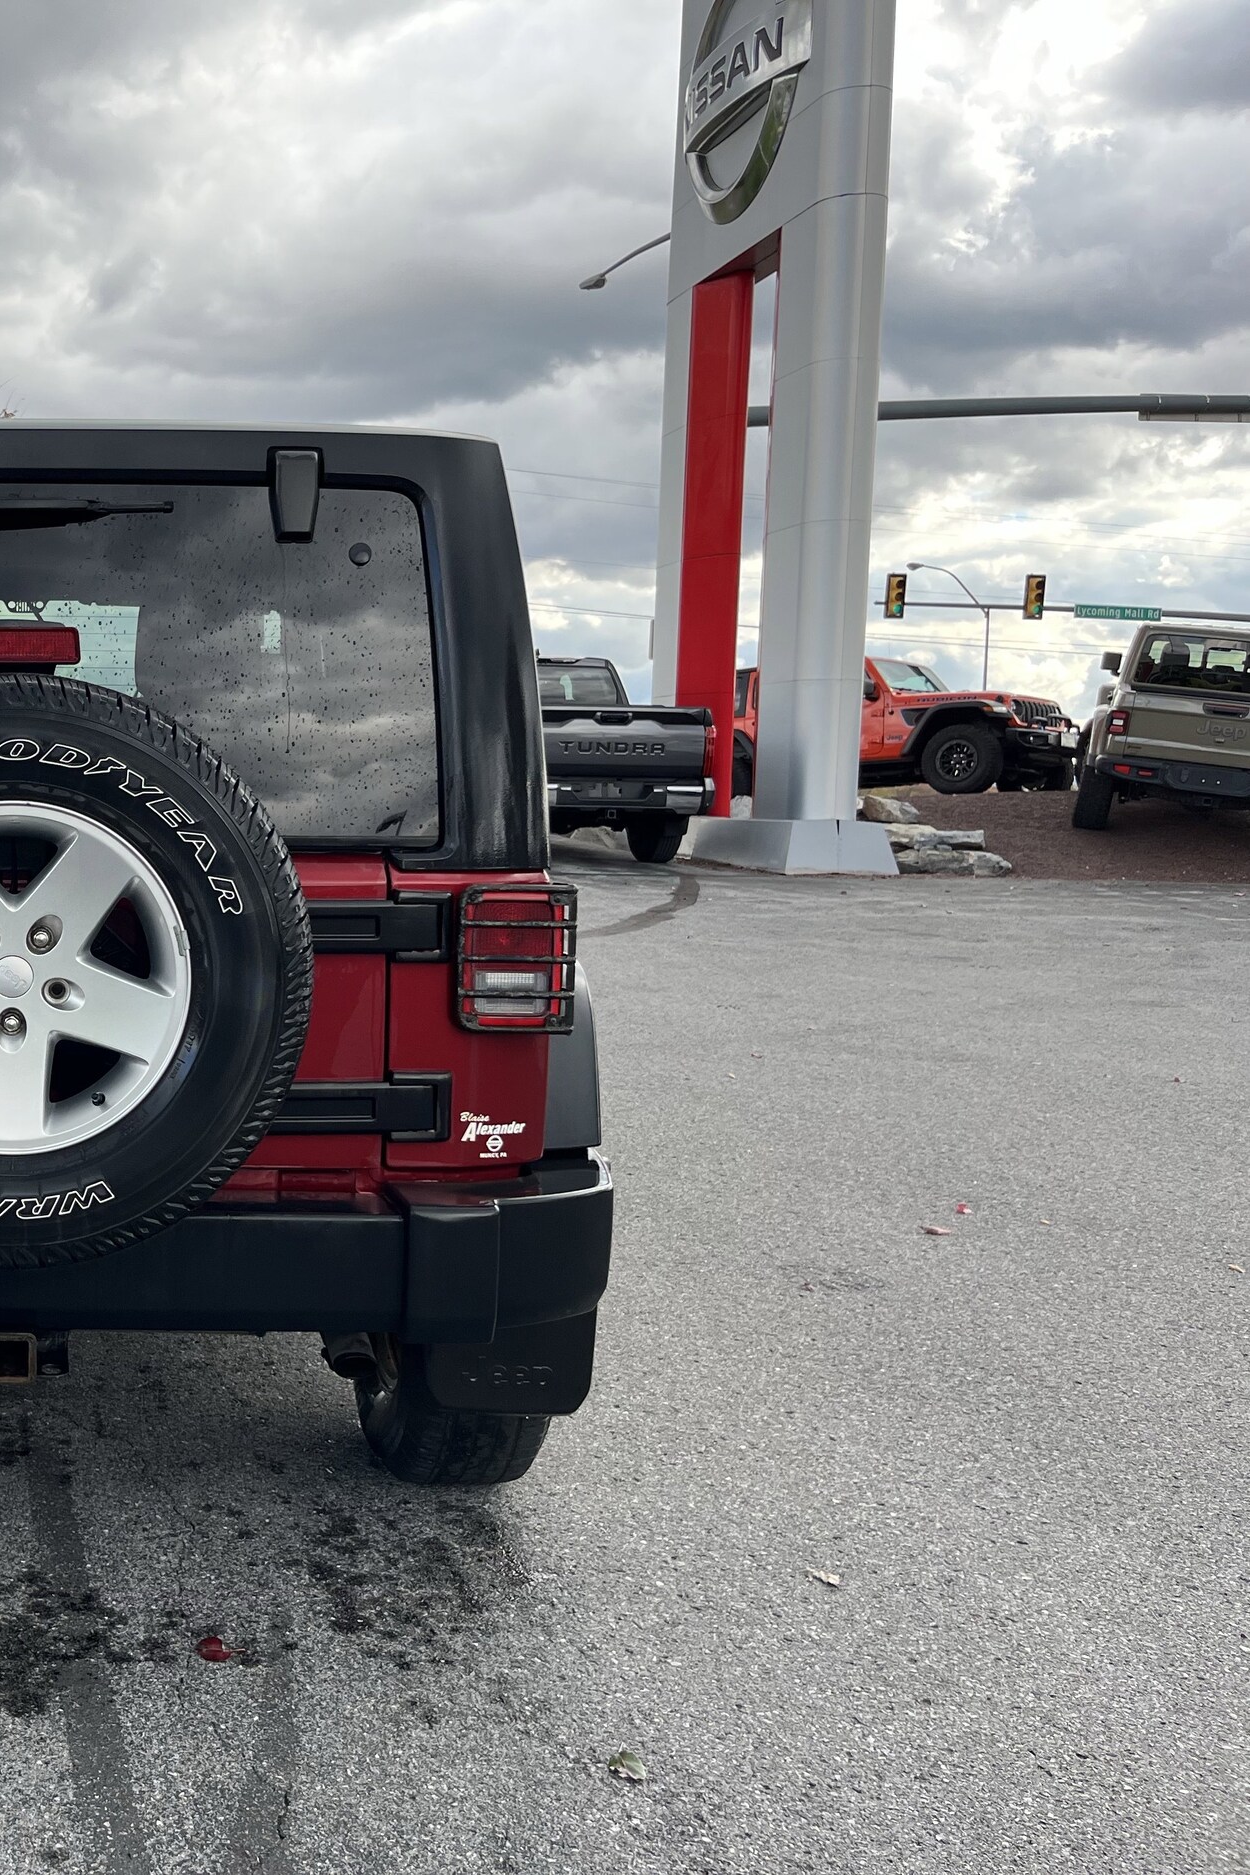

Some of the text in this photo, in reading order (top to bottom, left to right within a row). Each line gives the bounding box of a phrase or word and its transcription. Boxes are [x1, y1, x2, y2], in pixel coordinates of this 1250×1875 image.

[685, 16, 785, 132] NISSAN
[1077, 606, 1159, 619] Lycoming Mall Rd
[886, 733, 904, 742] Jeep
[1196, 720, 1247, 741] Jeep
[558, 740, 666, 756] TUNDRA
[460, 1111, 489, 1121] Blaise
[460, 1121, 526, 1142] Alexander
